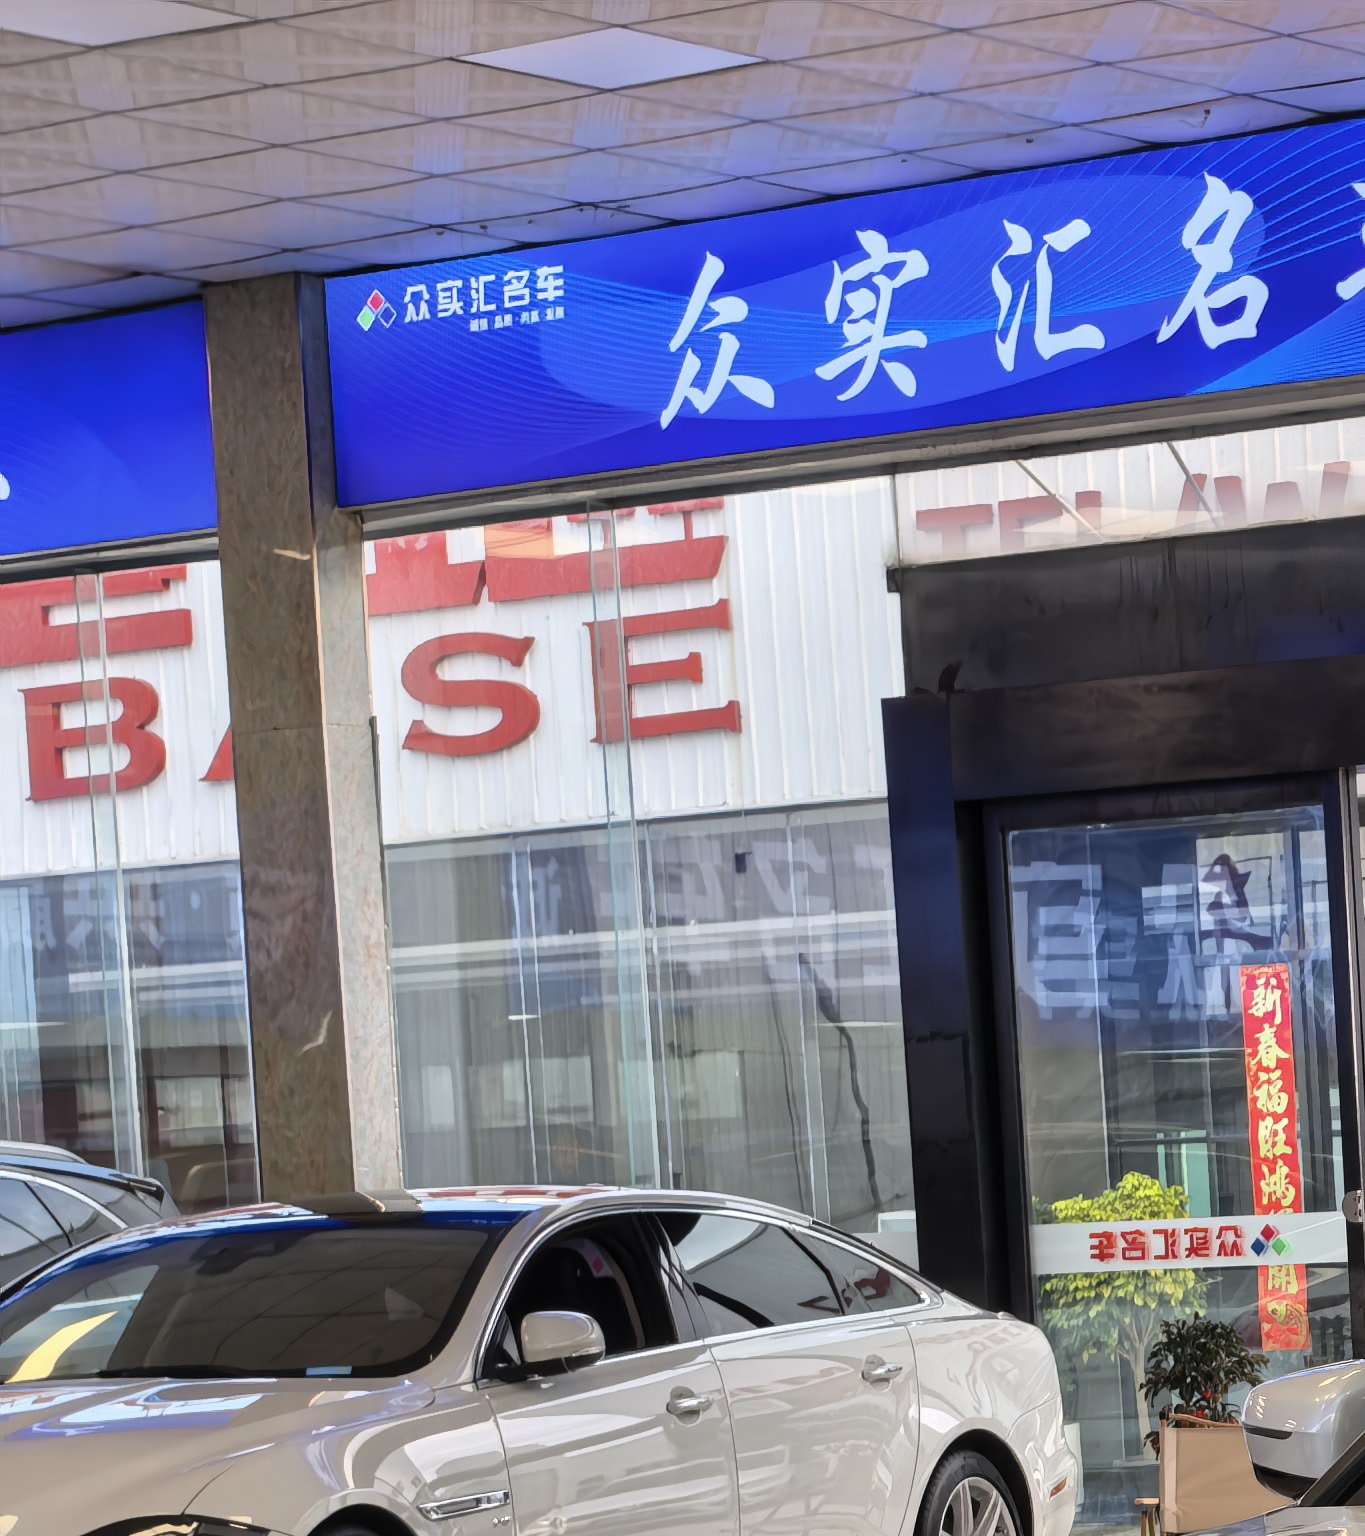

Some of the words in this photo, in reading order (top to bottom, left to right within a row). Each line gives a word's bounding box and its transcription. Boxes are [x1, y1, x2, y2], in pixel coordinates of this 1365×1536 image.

[403, 264, 565, 323] 众实汇名车
[18, 598, 742, 802] BSE
